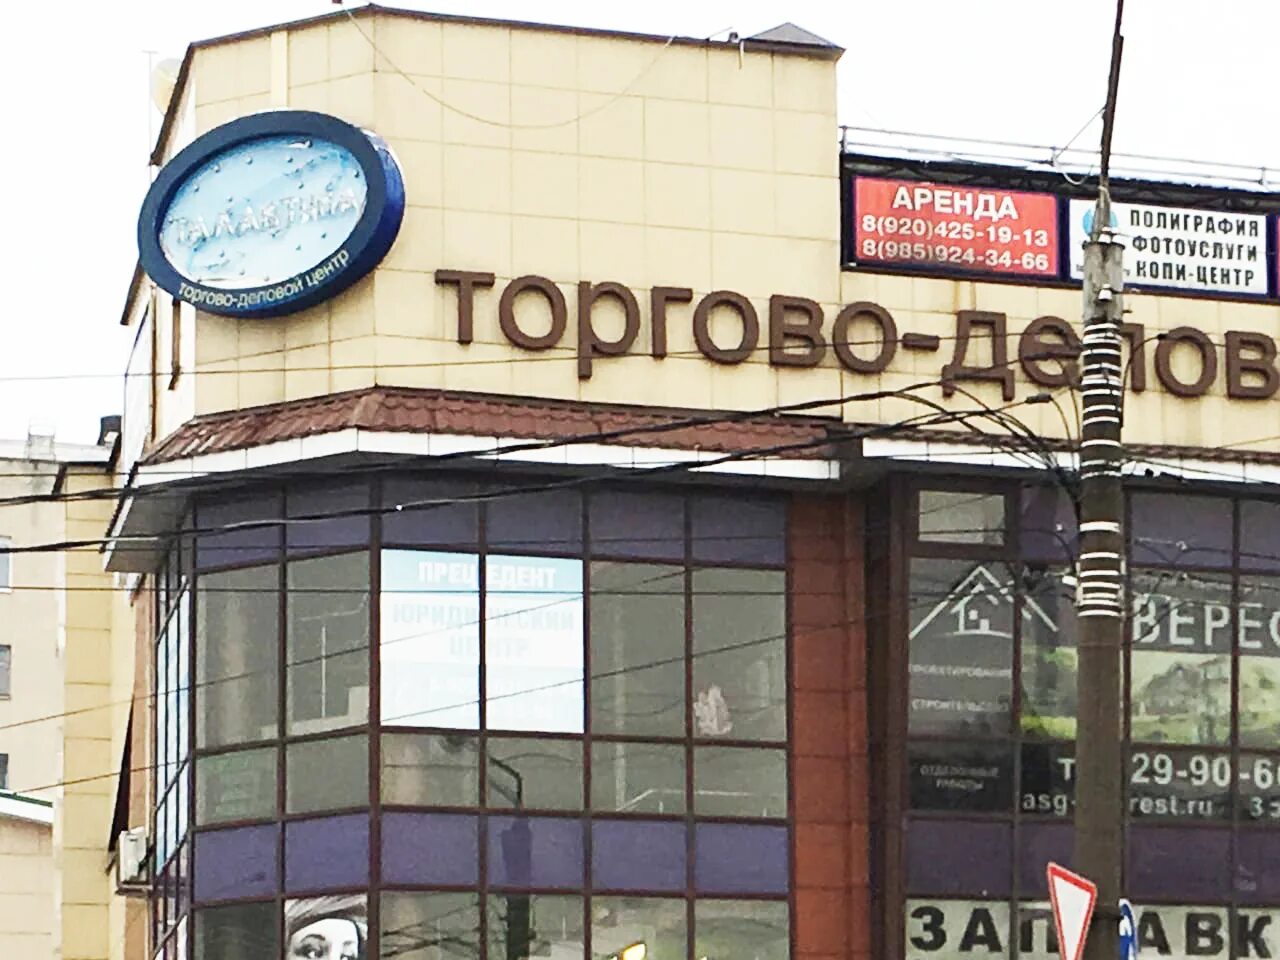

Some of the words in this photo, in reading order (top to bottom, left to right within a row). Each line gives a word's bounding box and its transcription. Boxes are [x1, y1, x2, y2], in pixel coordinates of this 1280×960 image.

[893, 187, 1018, 221] АРЕНДА
[862, 215, 1048, 247] 8(920)425-19-13
[1130, 209, 1259, 236] ПОЛИГРАФИЯ
[862, 239, 1049, 270] 8(985)924-34-66
[1132, 235, 1257, 261] ФОТОУСЛУГИ
[1136, 260, 1255, 287] КОПИ-ЦЕНТР
